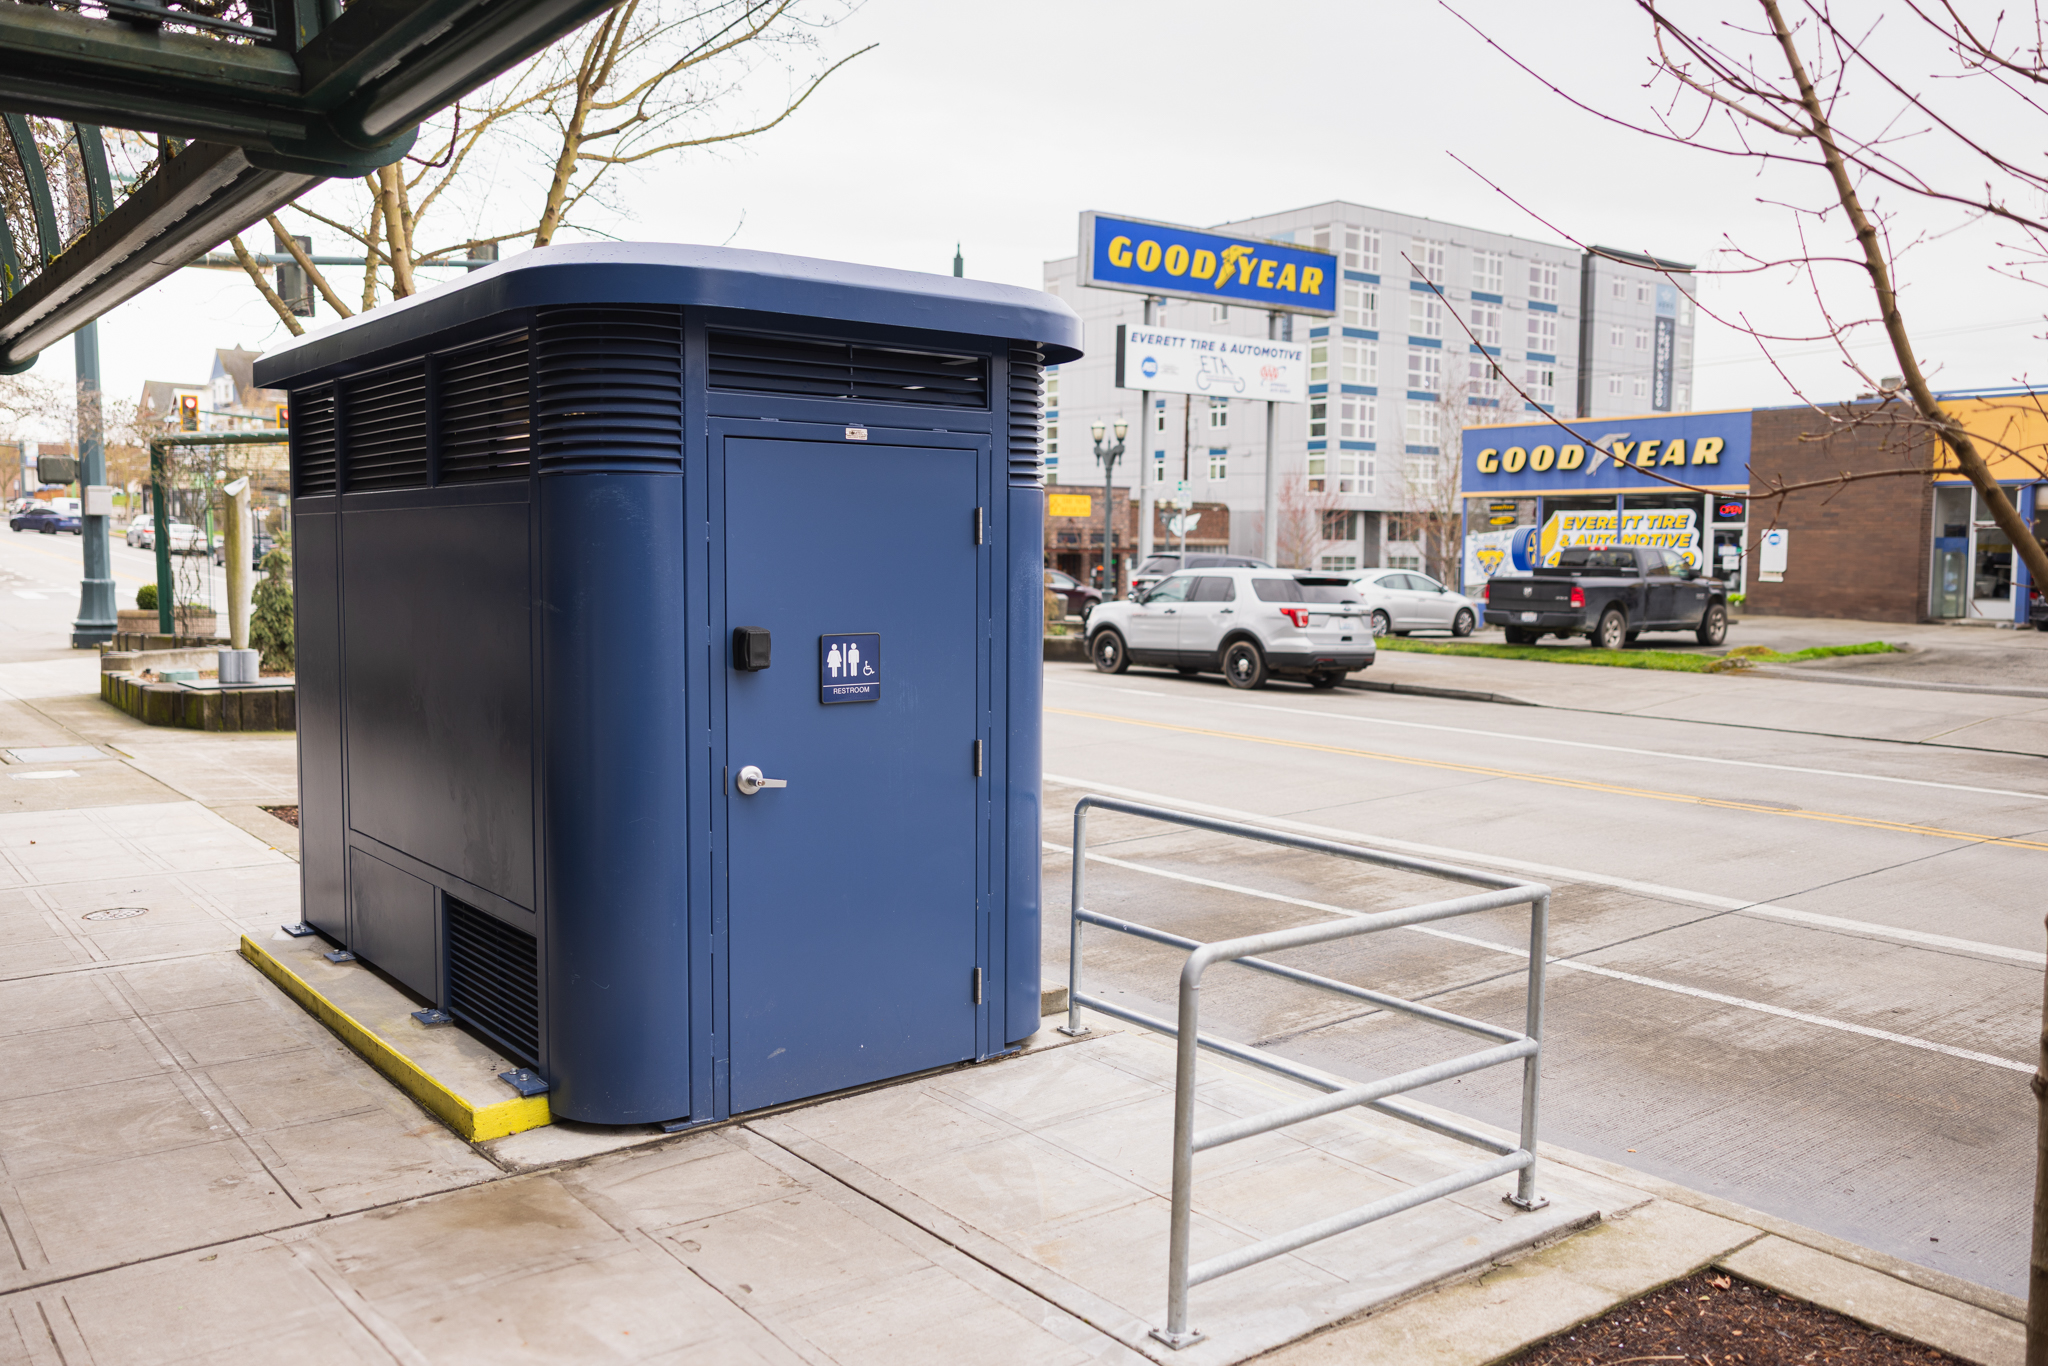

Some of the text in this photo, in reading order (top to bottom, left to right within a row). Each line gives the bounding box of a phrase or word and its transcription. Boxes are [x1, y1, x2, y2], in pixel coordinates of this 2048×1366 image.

[1108, 236, 1323, 295] GOODYEAR
[1131, 332, 1302, 361] EVERETT TIRE & AUTOMOTIVE
[1477, 437, 1725, 474] GOODYEAR
[1719, 504, 1742, 514] OPEN
[1563, 515, 1690, 530] EVERETT TIRE
[1559, 534, 1570, 547] &
[833, 686, 870, 695] RESTROOM
